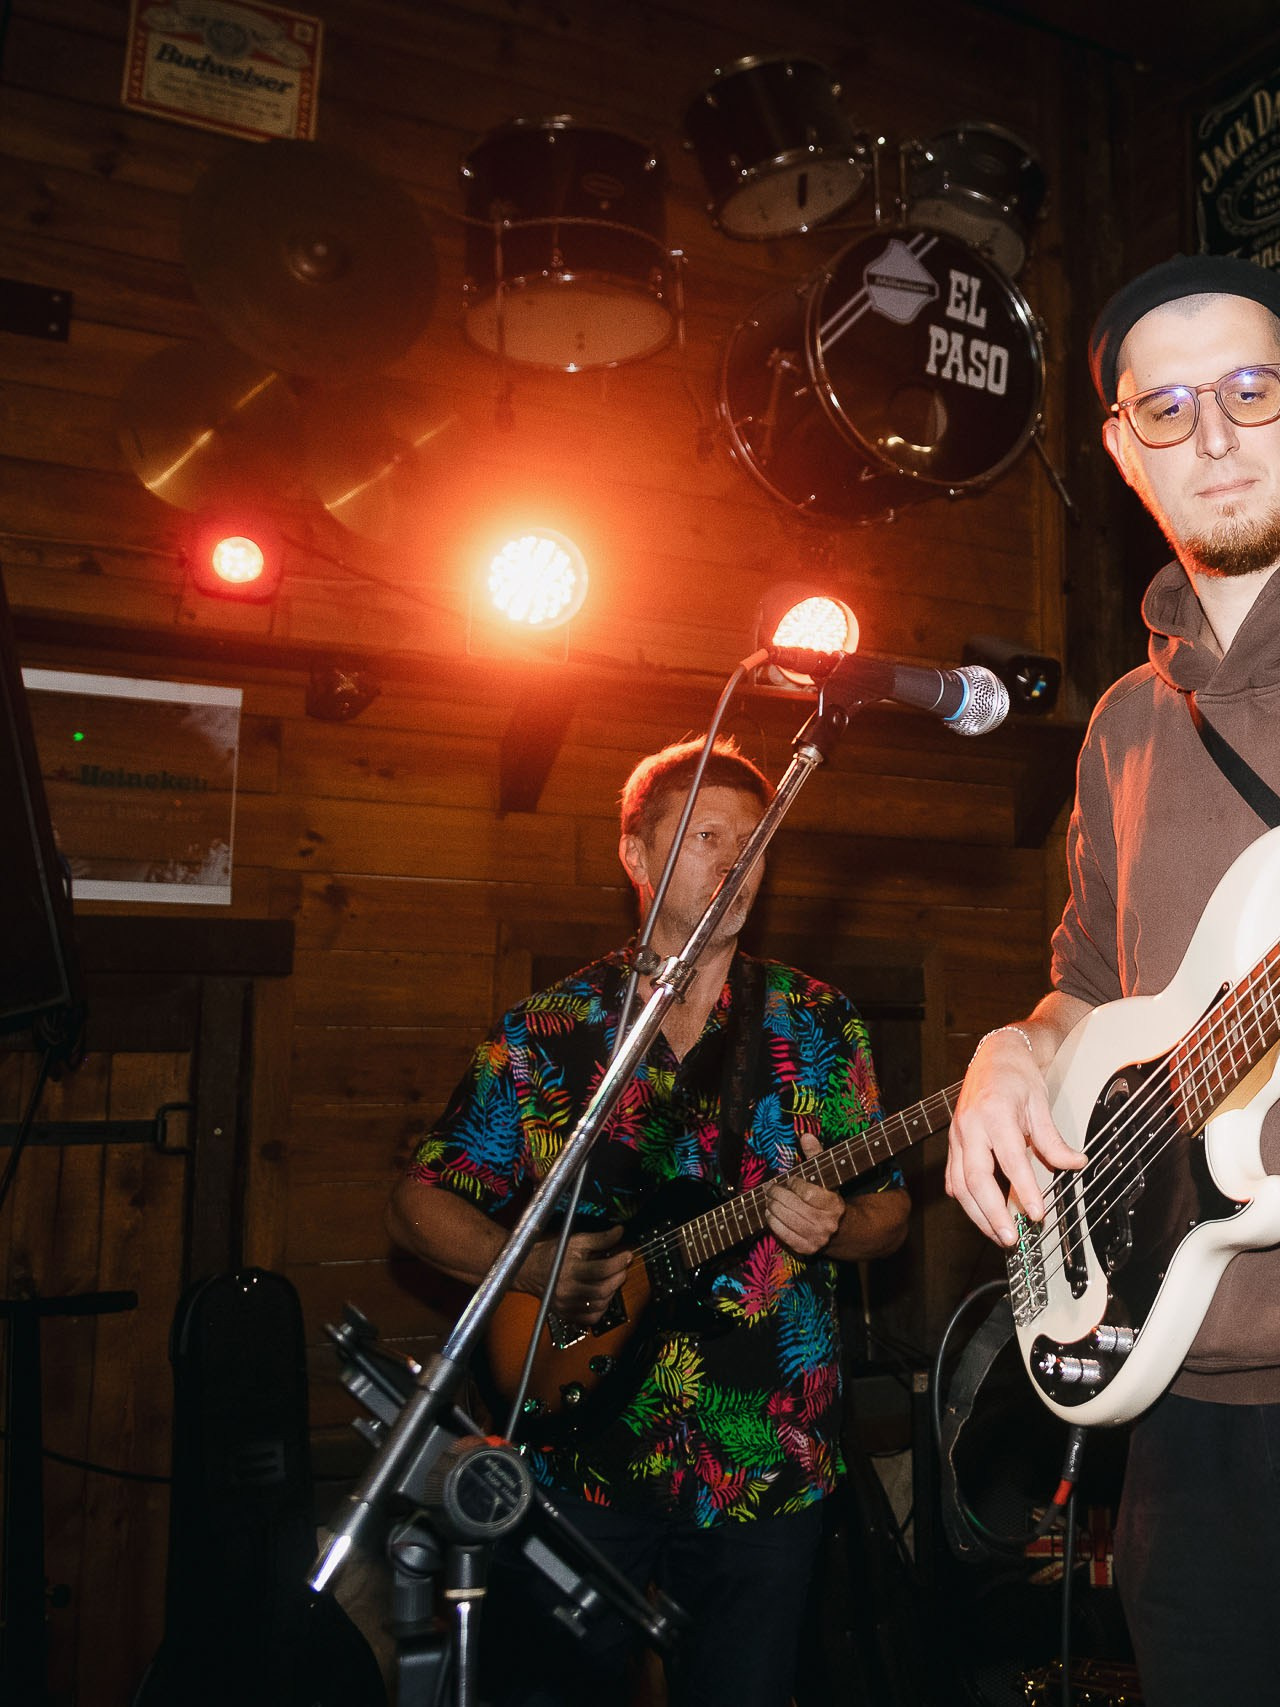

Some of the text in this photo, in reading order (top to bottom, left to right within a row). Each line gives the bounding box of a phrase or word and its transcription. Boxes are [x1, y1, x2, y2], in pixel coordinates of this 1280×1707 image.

[156, 43, 293, 93] Budweiser
[1200, 112, 1256, 192] JACK
[947, 269, 987, 328] EL
[926, 324, 1009, 395] PASO
[80, 764, 208, 792] Heineken
